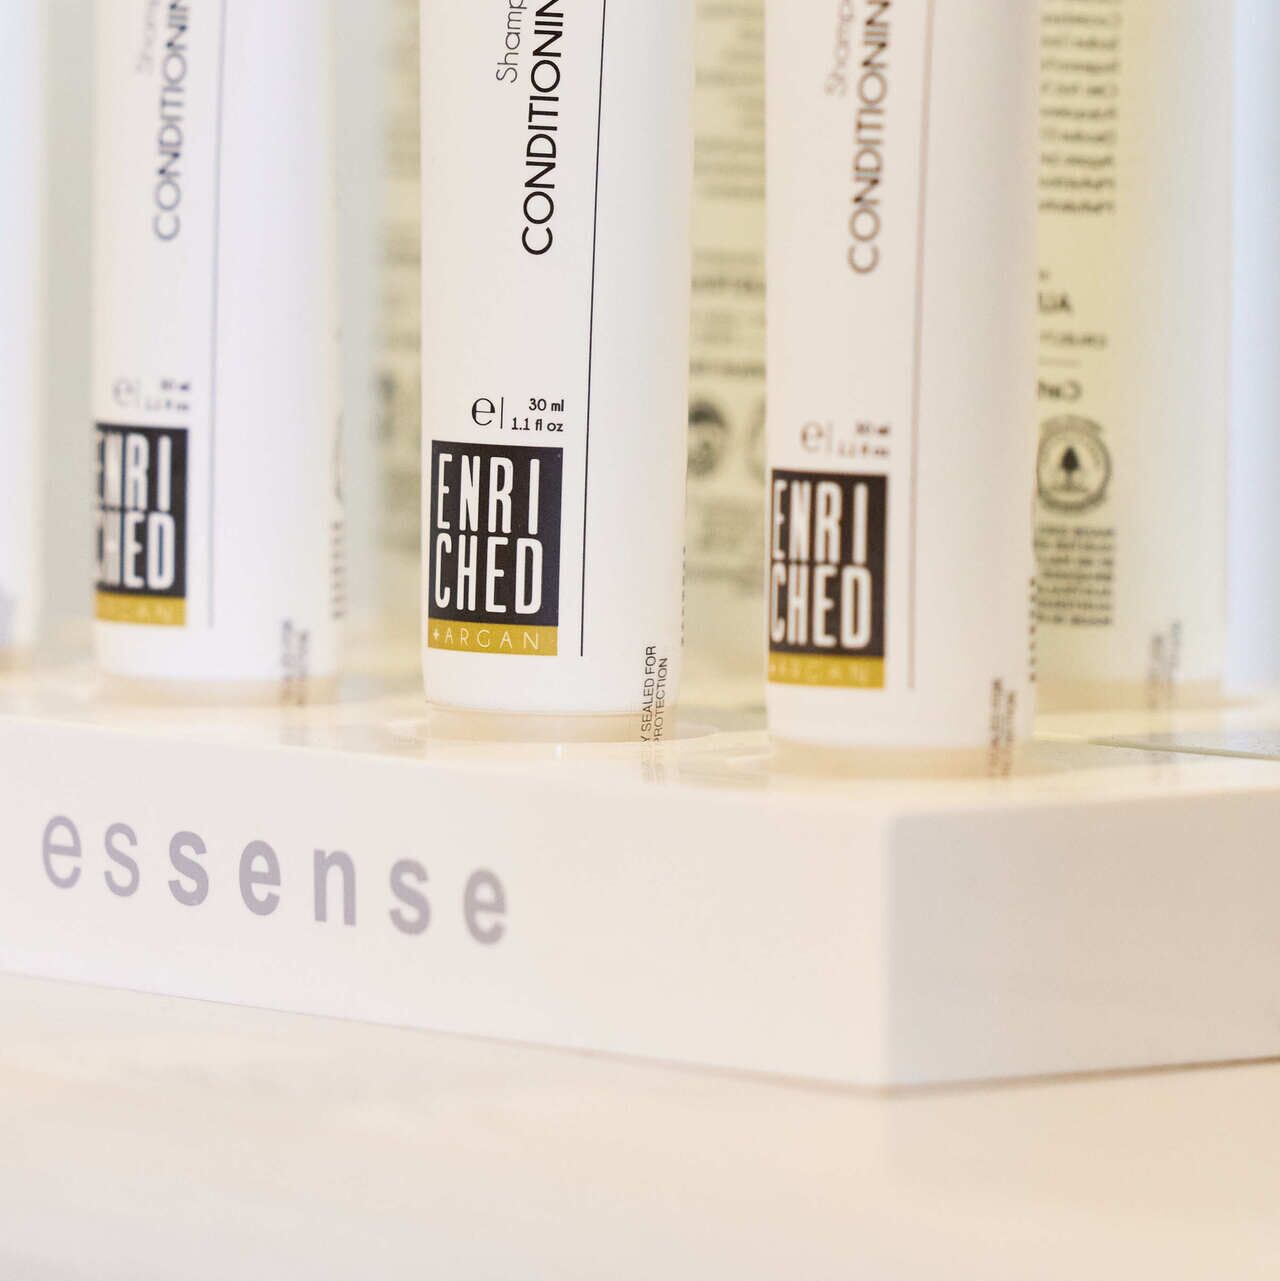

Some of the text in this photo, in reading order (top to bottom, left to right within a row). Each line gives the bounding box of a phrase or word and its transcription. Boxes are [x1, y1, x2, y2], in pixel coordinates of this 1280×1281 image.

[511, 418, 564, 432] 1.1 fl oz
[528, 398, 564, 412] 30 ml
[437, 453, 540, 535] ENRI
[771, 479, 868, 563] ENRI
[434, 533, 543, 614] CHED
[770, 562, 872, 649] CHED
[645, 645, 657, 674] FOR
[641, 678, 654, 733] SEALED
[41, 812, 508, 947] essense
